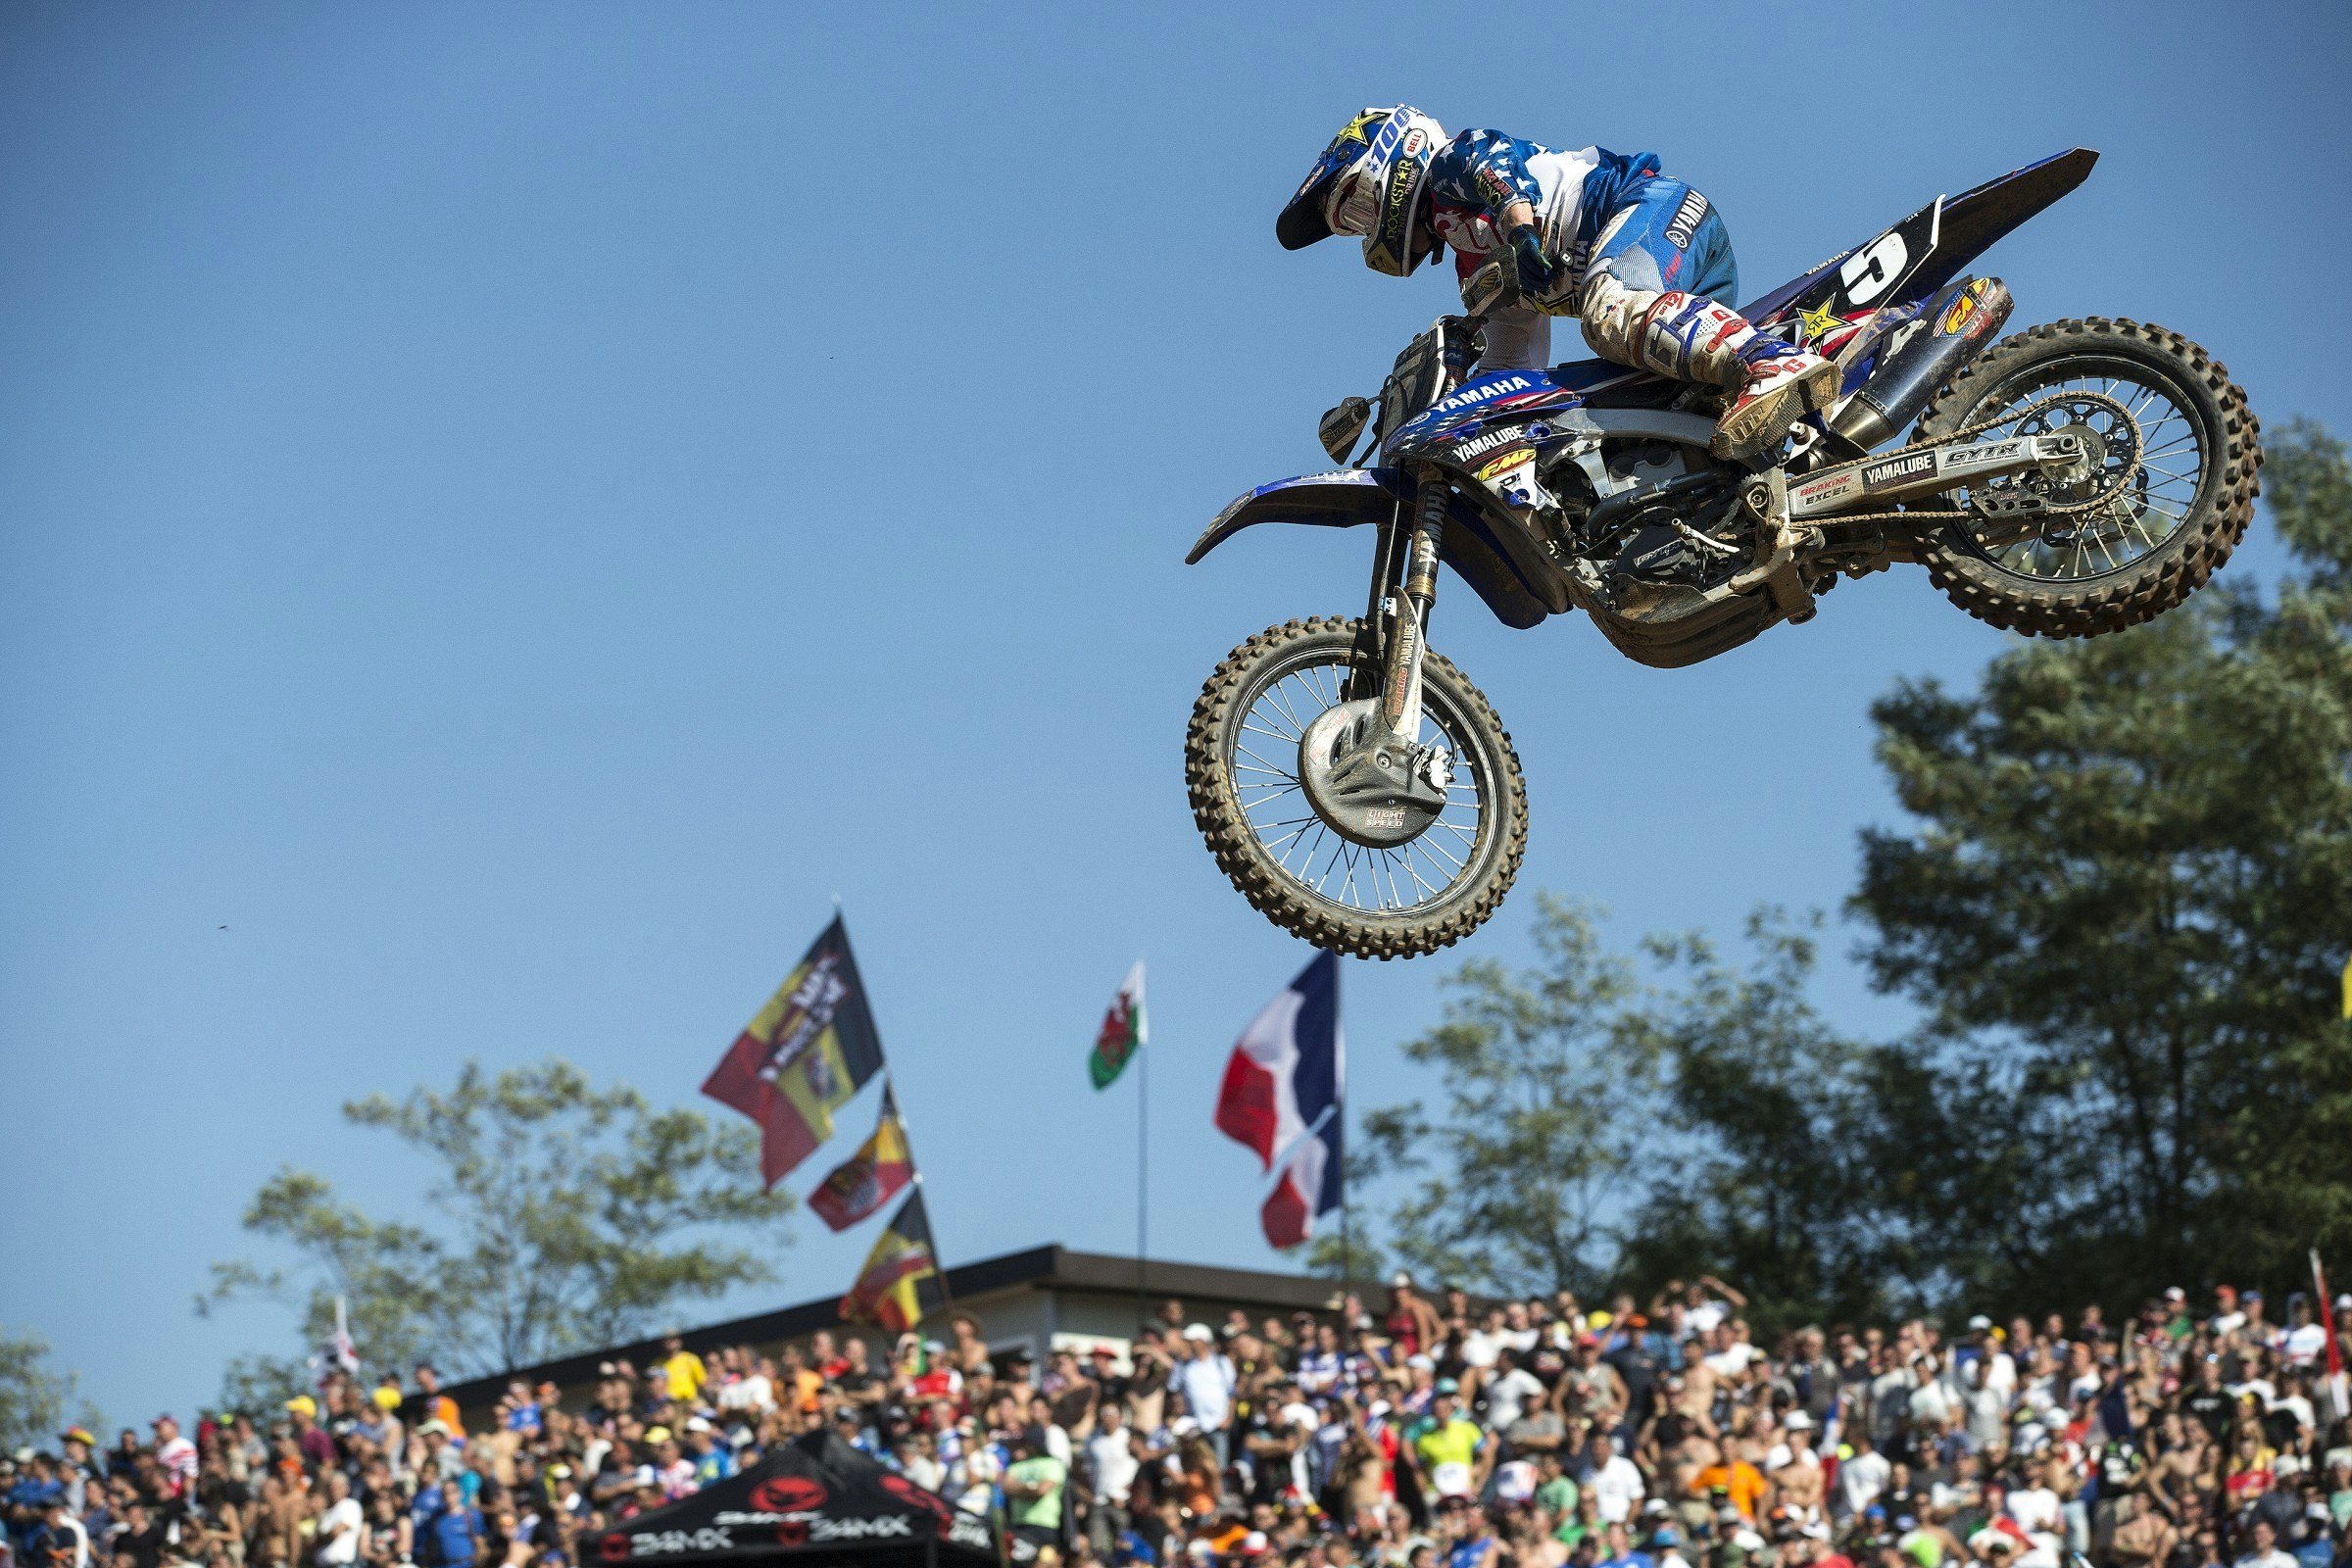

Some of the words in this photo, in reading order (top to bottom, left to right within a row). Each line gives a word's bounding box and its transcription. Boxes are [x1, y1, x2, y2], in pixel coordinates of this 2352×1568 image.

[1406, 133, 1422, 153] BELL
[1404, 168, 1420, 195] DRINK
[1672, 189, 1709, 235] YAMAHA
[1805, 251, 1850, 276] YAMAHA
[1840, 232, 1908, 305] 5
[1430, 376, 1532, 413] YAMAHA
[1452, 426, 1527, 463] YAMALUBE
[1945, 441, 2024, 465] GYTR
[1478, 448, 1536, 482] FMF
[1866, 454, 1933, 484] YAMALUBE
[1800, 473, 1852, 497] BRAKING
[1805, 486, 1850, 505] EXCEL
[1399, 623, 1417, 665] YAMALUBE
[1394, 666, 1408, 715] BRAKING
[1365, 818, 1403, 829] SPEED
[1367, 808, 1405, 820] LIGHT
